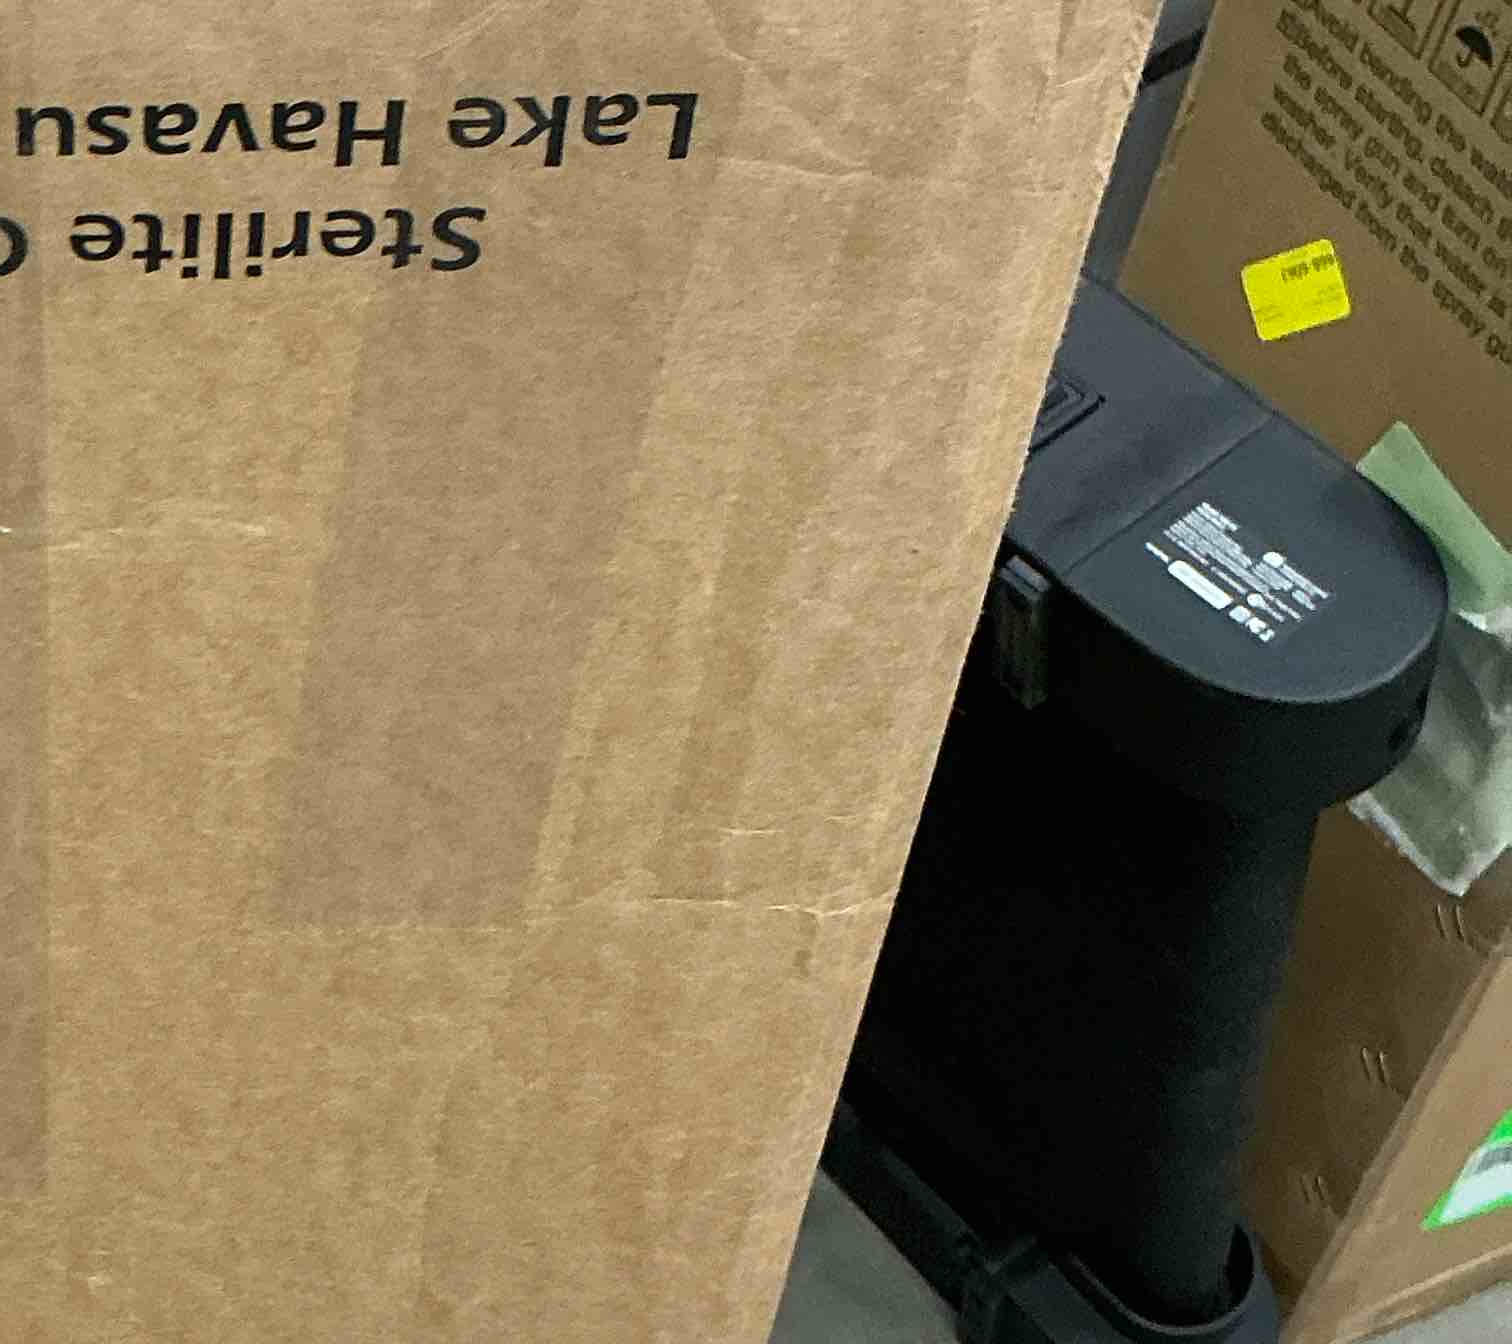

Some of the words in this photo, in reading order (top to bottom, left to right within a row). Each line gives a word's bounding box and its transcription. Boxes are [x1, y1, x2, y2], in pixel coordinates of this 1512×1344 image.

[15, 98, 407, 168] Havasu
[448, 91, 699, 168] Lake
[68, 206, 487, 280] Sterilite
